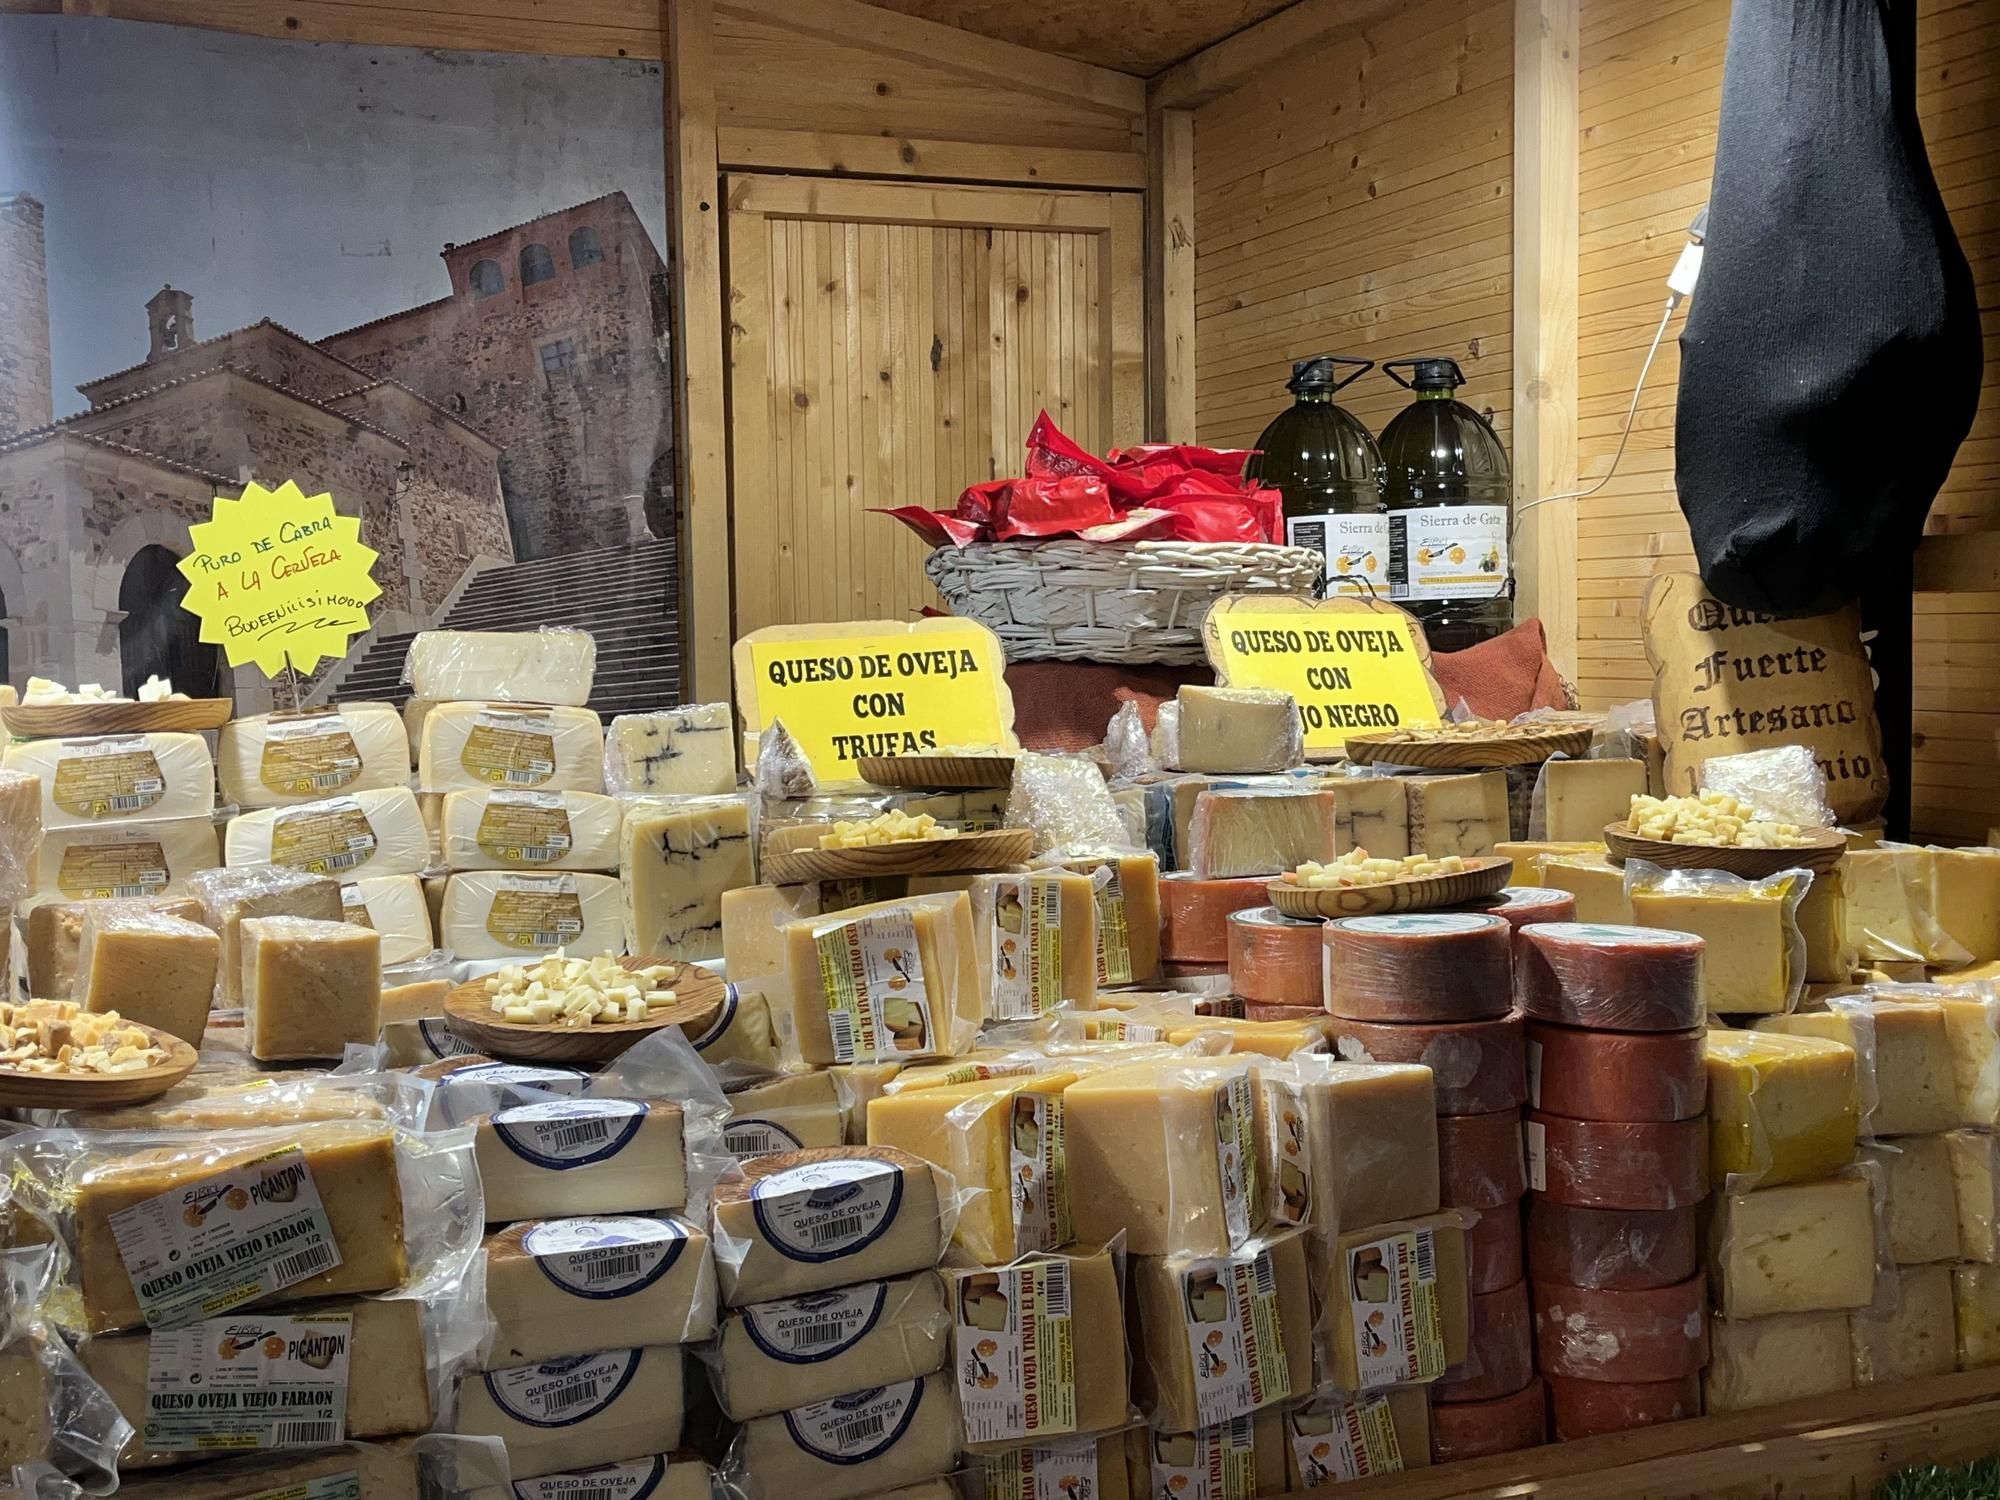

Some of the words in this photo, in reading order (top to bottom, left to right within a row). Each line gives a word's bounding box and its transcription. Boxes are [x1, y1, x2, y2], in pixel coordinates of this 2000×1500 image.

[1339, 520, 1374, 534] Sierra
[1420, 513, 1460, 528] Sierra
[1462, 512, 1477, 526] de
[1479, 511, 1501, 526] Gata
[193, 552, 241, 574] PURO
[250, 537, 274, 554] DE
[279, 516, 332, 544] CABRA
[217, 582, 229, 600] A
[241, 571, 261, 591] LA
[271, 546, 341, 580] CERVEZA
[1231, 630, 1302, 656] QUESO
[1303, 630, 1335, 652] DE
[1336, 629, 1404, 658] OVEJA
[768, 656, 854, 687] QUESO
[859, 654, 892, 679] DE
[897, 649, 978, 679] OVEJA
[1307, 667, 1352, 690] CON
[1692, 646, 1828, 693] Fuerte
[853, 692, 905, 719] CON
[1299, 705, 1323, 735] JO
[1324, 703, 1400, 728] NEGRO
[1680, 700, 1857, 742] Artesano
[832, 730, 937, 761] TRUFAS
[846, 923, 859, 946] UESO
[850, 949, 864, 978] OVEJA
[855, 980, 870, 1014] TINAJA
[860, 1015, 872, 1028] EL
[853, 1029, 861, 1044] 1/4
[534, 1118, 572, 1134] QUESO
[250, 1162, 306, 1206] PICANTON
[793, 1213, 830, 1228] QUESO
[831, 1208, 845, 1219] DE
[847, 1199, 882, 1215] OVEJA
[798, 1229, 808, 1237] 1/2
[865, 1211, 876, 1220] 1/2
[306, 1233, 321, 1246] 1/2
[569, 1249, 608, 1265] QUESO
[610, 1246, 625, 1255] DE
[627, 1241, 663, 1252] OVEJA
[140, 1270, 182, 1298] QUESO
[186, 1254, 226, 1279] OVEJA
[228, 1239, 263, 1265] VIEJO
[264, 1216, 316, 1248] FARAON
[573, 1264, 583, 1273] 1/2
[645, 1252, 655, 1260] 1/2
[1398, 1243, 1408, 1265] BICI
[1021, 1271, 1034, 1294] BICI
[1400, 1266, 1409, 1280] EL
[1237, 1283, 1248, 1295] EL
[1400, 1280, 1413, 1317] TINAJA
[1022, 1297, 1034, 1310] EL
[1241, 1300, 1254, 1333] TINAJA
[777, 1313, 813, 1329] QUESO
[814, 1313, 828, 1322] DE
[831, 1308, 864, 1321] OVEJA
[781, 1330, 790, 1338] 1/2
[847, 1320, 856, 1328] 1/2
[1022, 1314, 1036, 1353] TINAJA
[1405, 1319, 1415, 1351] OVEJA
[288, 1335, 345, 1360] PICANTON
[1245, 1335, 1258, 1368] OVEJA
[525, 1378, 565, 1397] QUESO
[566, 1373, 581, 1386] DE
[583, 1362, 619, 1380] OVEJA
[1024, 1355, 1037, 1389] OVEJA
[152, 1394, 193, 1409] QUESO
[200, 1393, 237, 1409] OVEJA
[242, 1392, 277, 1408] VIEJO
[281, 1391, 333, 1406] FARAON
[530, 1397, 540, 1406] 1/2
[601, 1375, 612, 1384] 1/2
[1250, 1370, 1264, 1404] QUESO
[318, 1410, 333, 1419] 1/2
[820, 1414, 853, 1432] QUESO
[855, 1408, 869, 1420] DE
[871, 1398, 903, 1413] OVEJA
[1025, 1393, 1039, 1429] QUESO
[824, 1431, 833, 1440] 1/2
[886, 1410, 896, 1418] 1/2
[1346, 1413, 1362, 1444] TINAJA
[1210, 1433, 1221, 1446] EL
[1021, 1448, 1033, 1473] UESO
[1210, 1448, 1222, 1484] TINAJA
[1353, 1451, 1370, 1476] OVEJA
[539, 1479, 579, 1490] QUESO
[582, 1478, 597, 1487] DE
[600, 1476, 637, 1486] OVEJA
[542, 1490, 553, 1499] 1/2
[617, 1487, 628, 1495] 1/2
[1022, 1476, 1034, 1500] OVE
